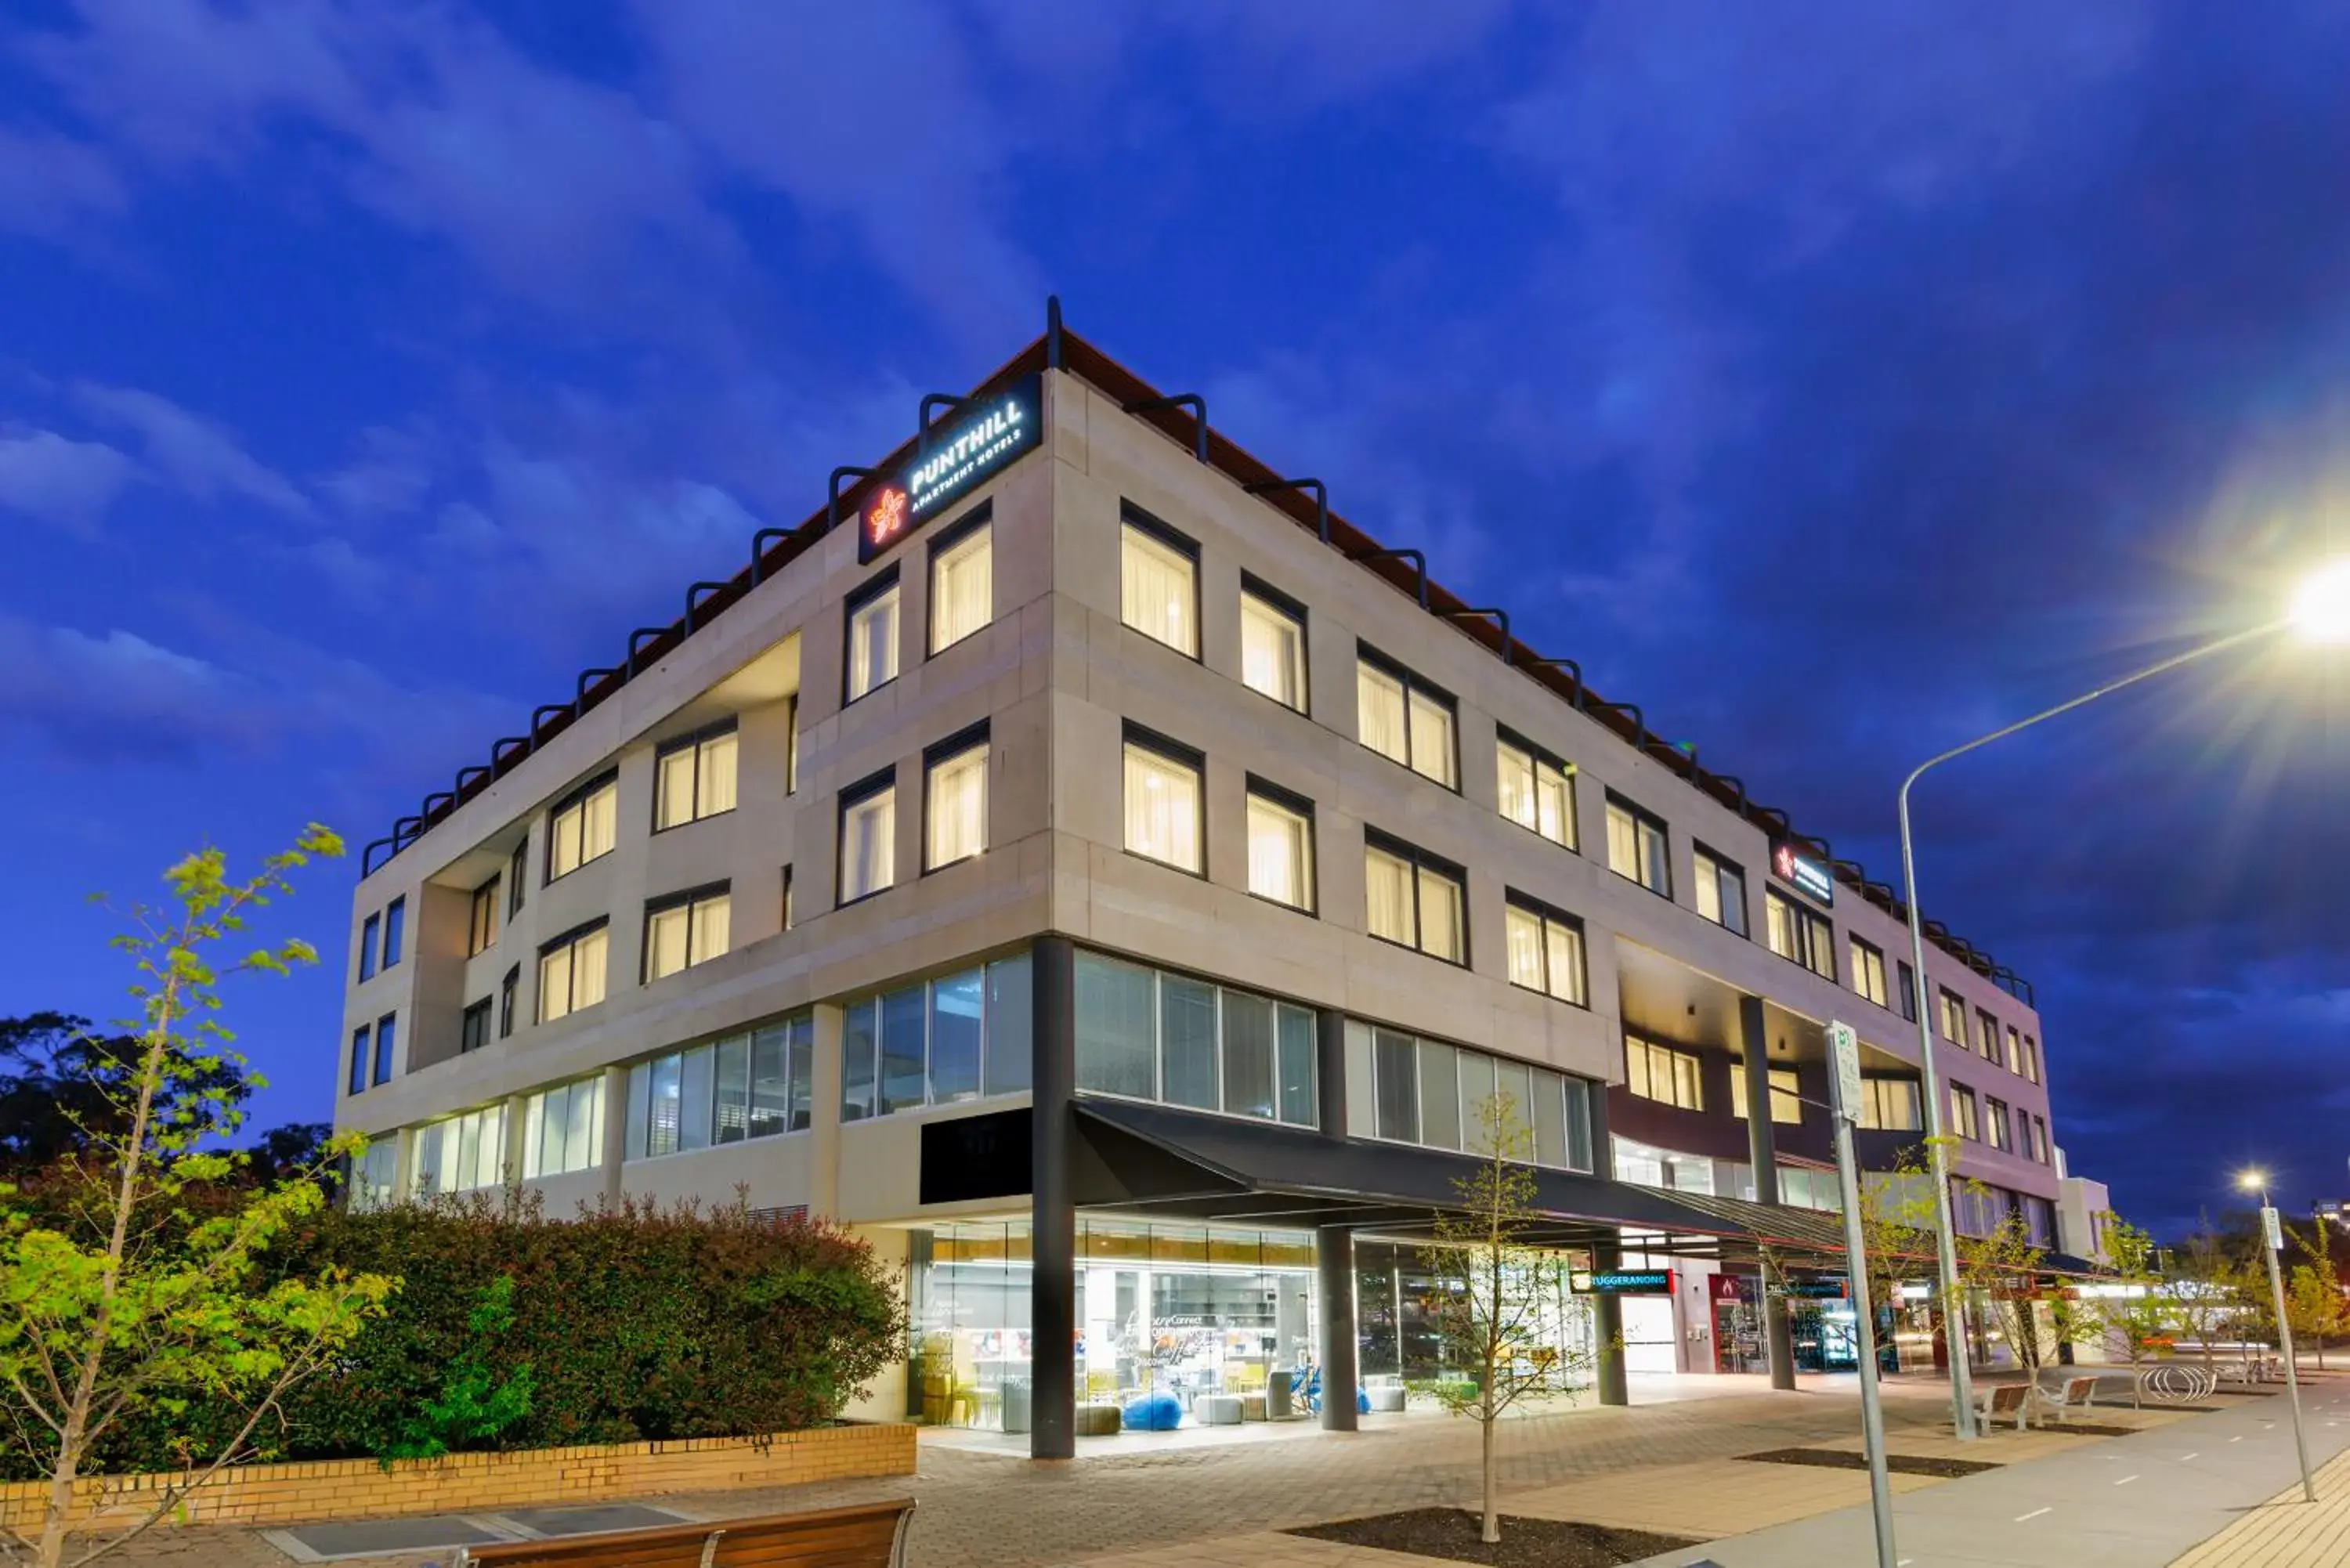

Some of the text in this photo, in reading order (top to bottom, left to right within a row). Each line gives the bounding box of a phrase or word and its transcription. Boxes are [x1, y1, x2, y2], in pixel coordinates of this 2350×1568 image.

[911, 400, 1022, 494] PUNTHILL
[912, 428, 1021, 513] APARTMENT HOTELS
